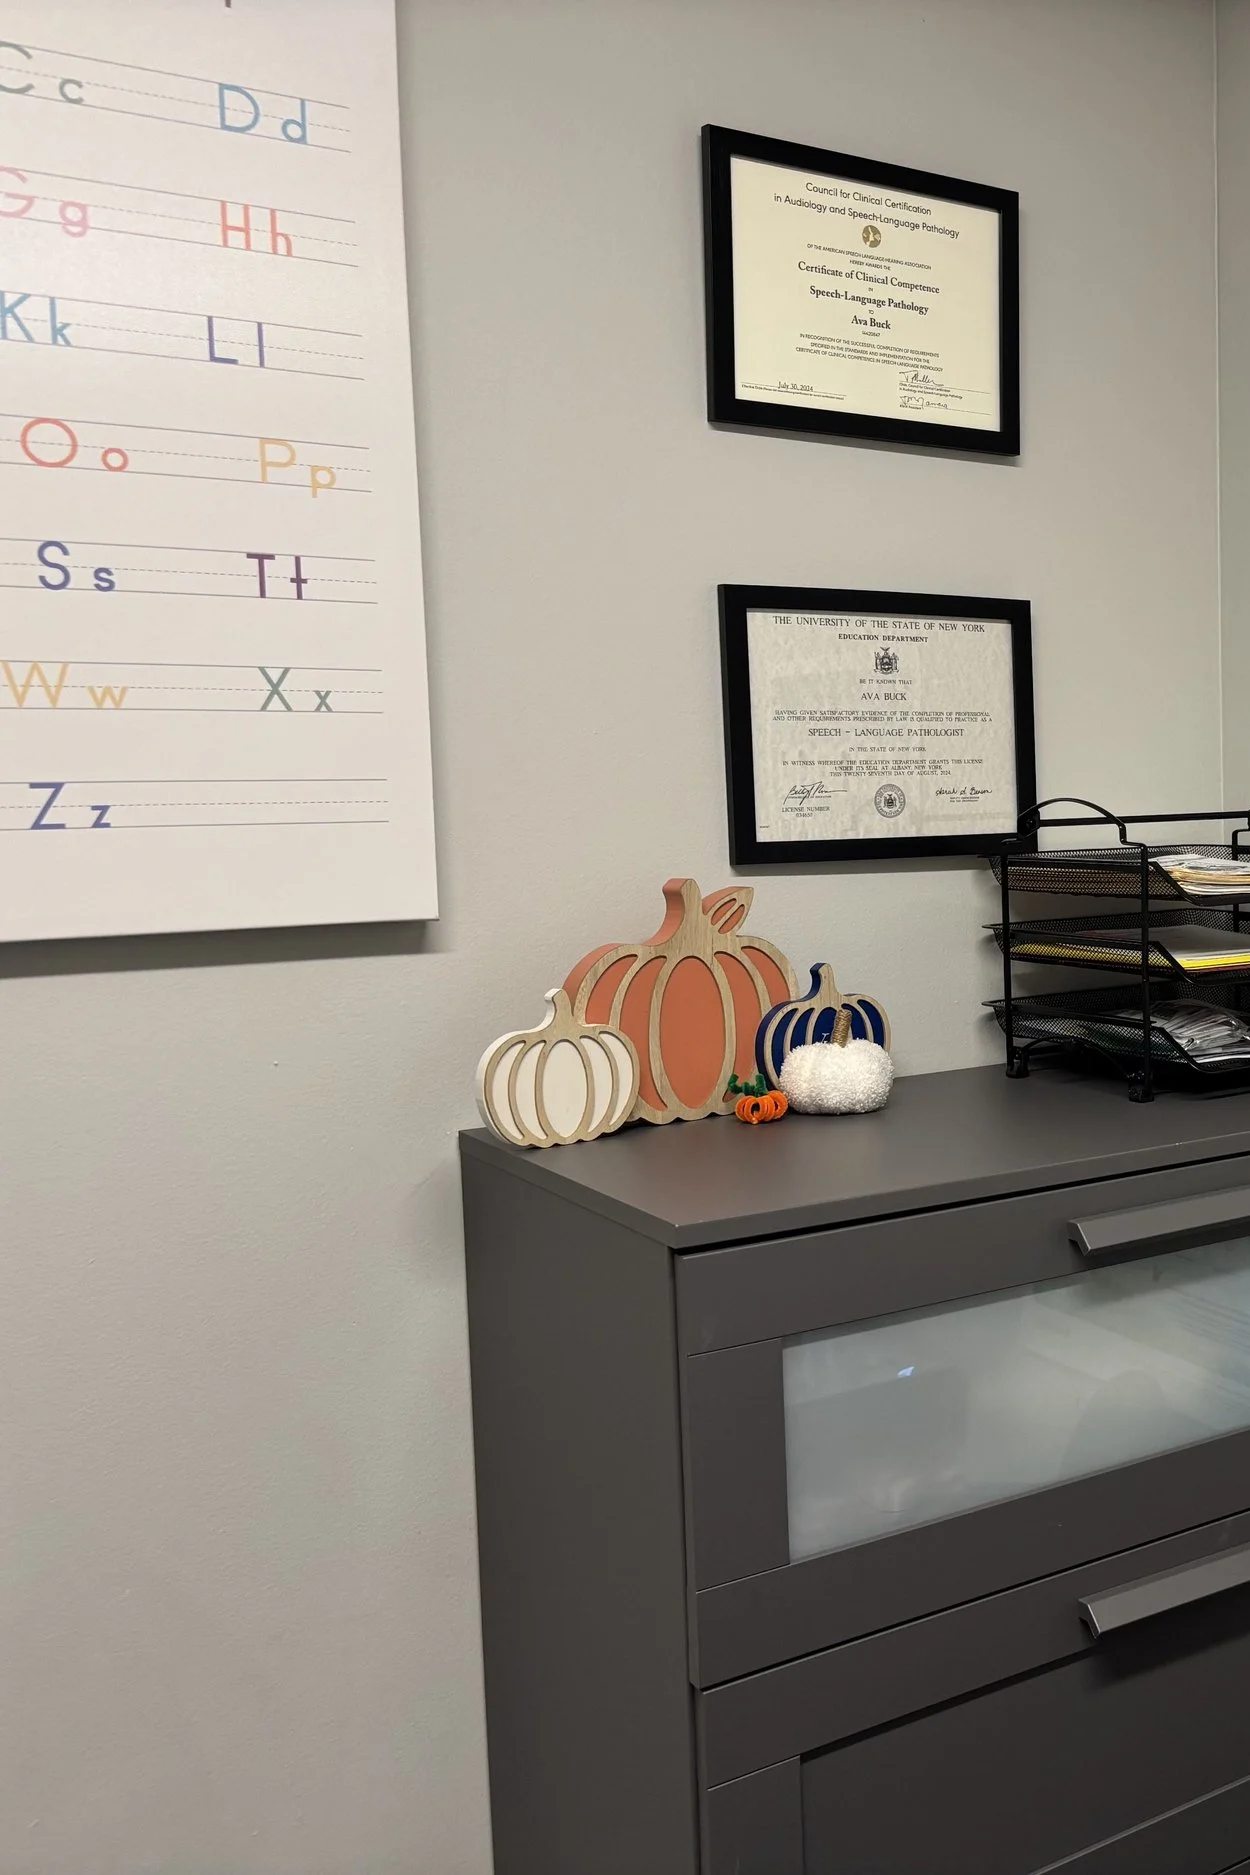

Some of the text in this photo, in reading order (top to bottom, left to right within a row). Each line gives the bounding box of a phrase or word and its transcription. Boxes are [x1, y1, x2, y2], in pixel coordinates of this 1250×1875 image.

[805, 182, 931, 215] Council for Clinical Certification
[774, 193, 782, 202] in
[784, 195, 827, 213] Audiology
[828, 206, 846, 215] and
[922, 222, 960, 239] Pathology
[798, 260, 939, 294] Certificate of Clinical Competence
[887, 297, 929, 315] Pathology
[851, 314, 891, 329] Ava Buck
[778, 381, 789, 390] July
[772, 615, 985, 632] THE UNIVERSITY OF THE STATE OF NEW YORK
[882, 635, 928, 643] DEPARTMENT
[860, 692, 907, 701] AVA BUCK
[808, 728, 841, 736] SPEECH
[854, 728, 904, 736] LANGUAGE
[907, 728, 964, 736] PATHOLOGIST
